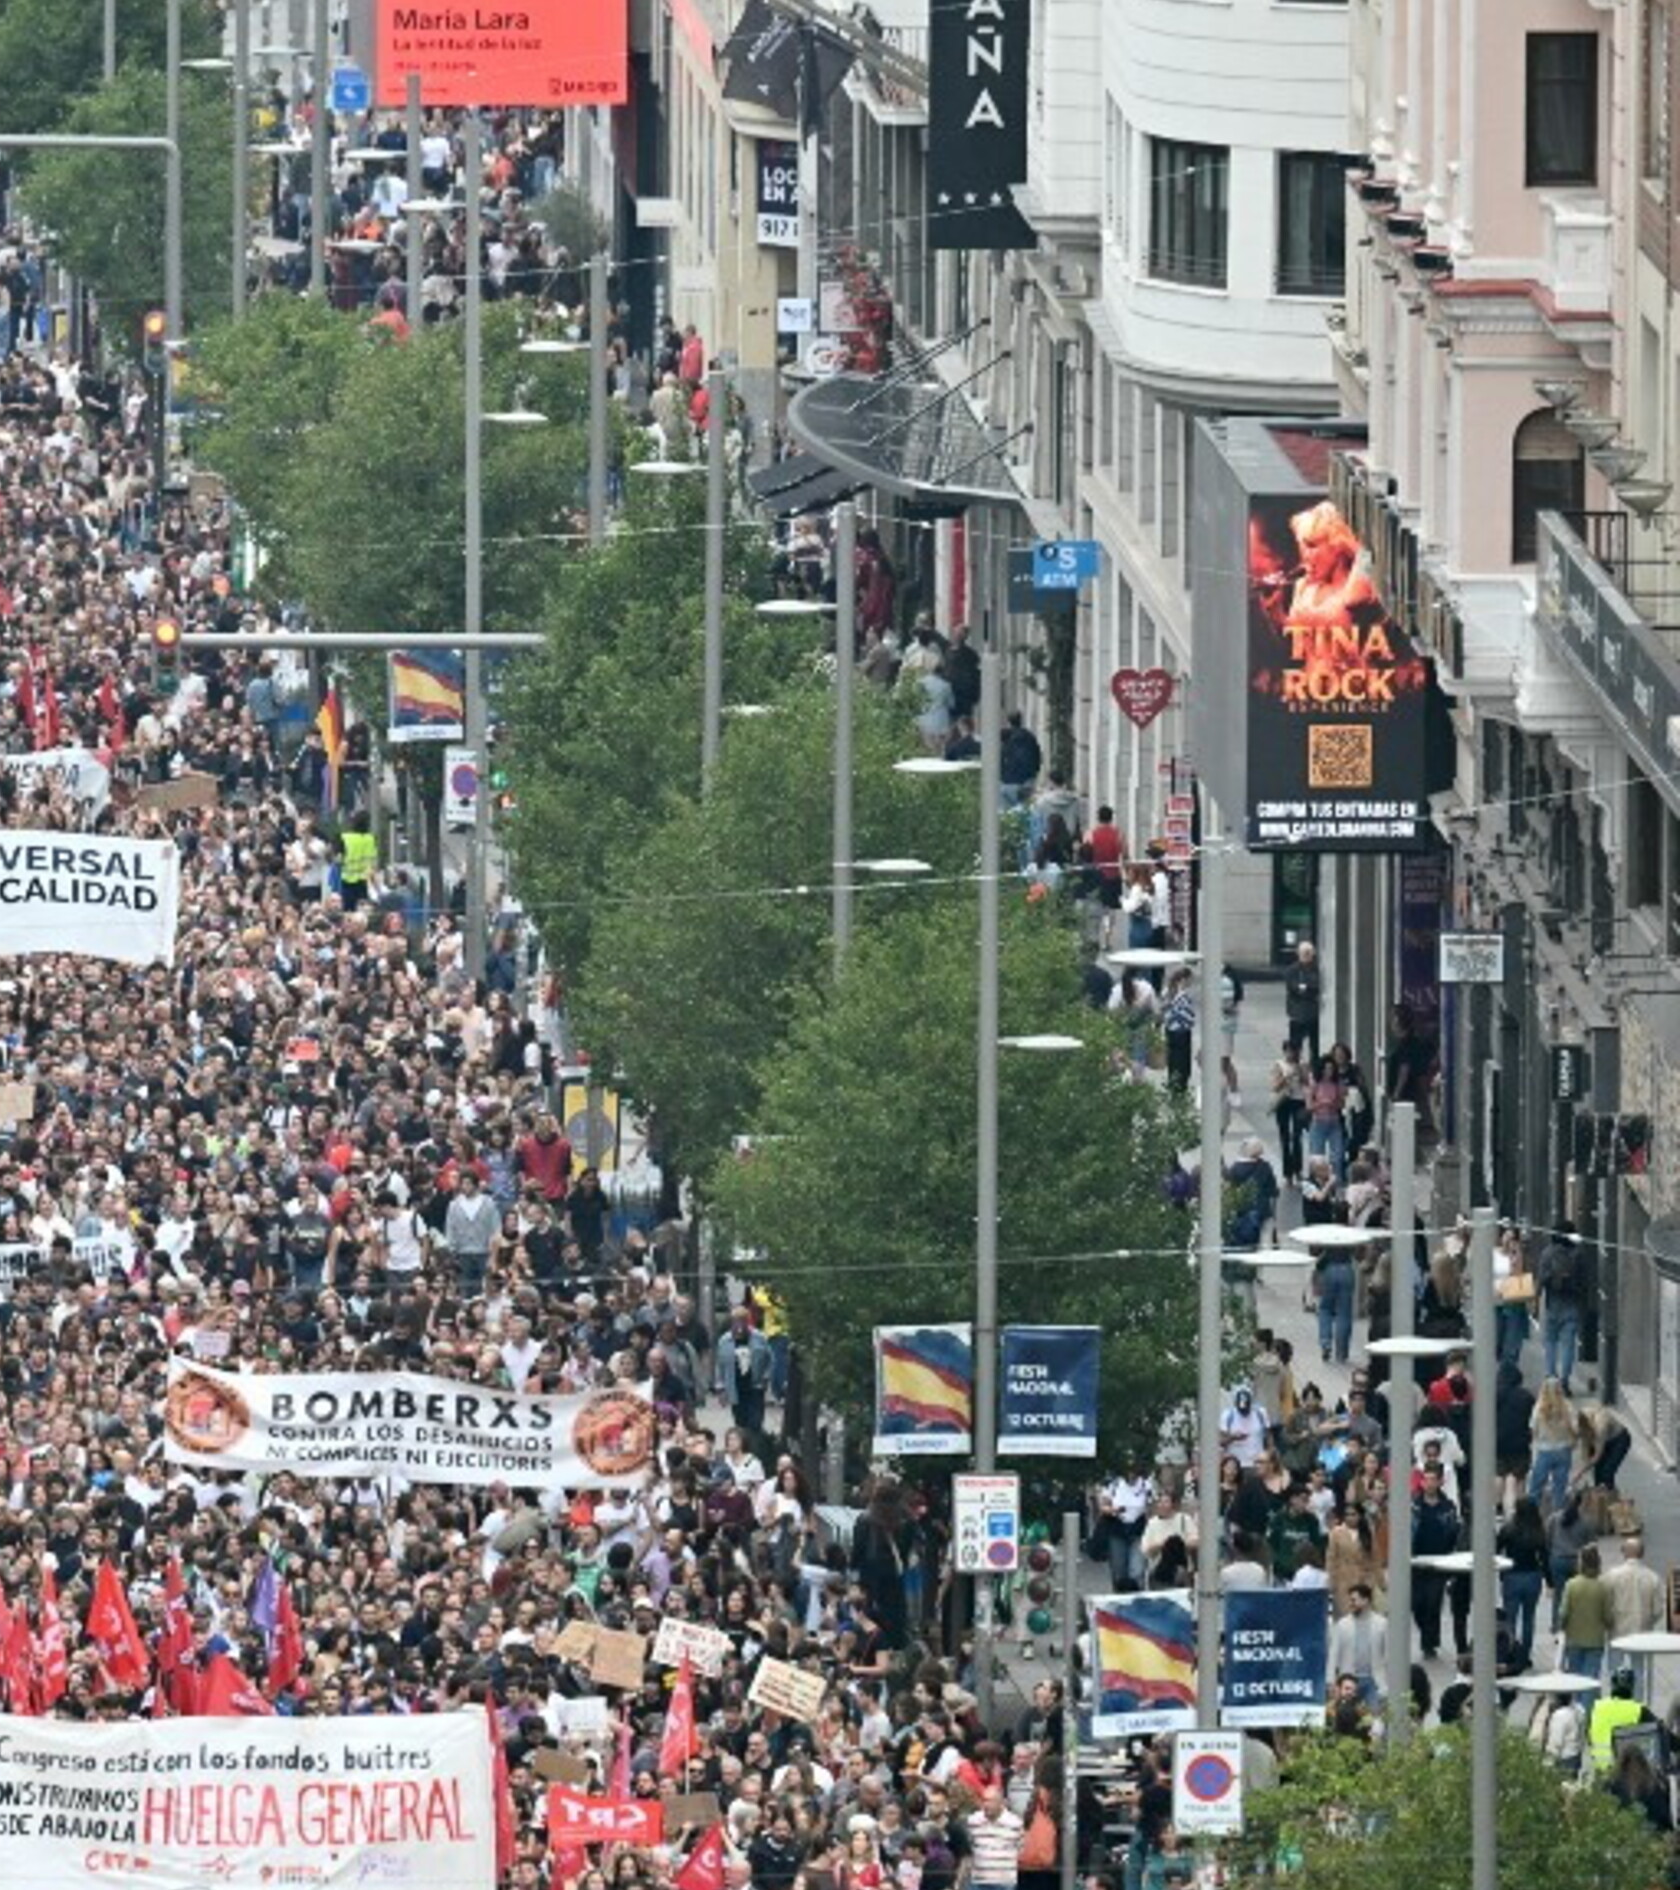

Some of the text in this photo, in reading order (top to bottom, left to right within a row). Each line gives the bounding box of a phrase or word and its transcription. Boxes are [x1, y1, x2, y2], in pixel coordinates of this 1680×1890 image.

[393, 8, 530, 30] María Lara
[1042, 573, 1077, 586] ATM
[1282, 626, 1395, 661] TINA
[1281, 669, 1396, 701] ROCK
[0, 878, 158, 912] CALIDAD
[1008, 1364, 1048, 1379] FIESTA
[1007, 1381, 1075, 1396] NACIONAL
[270, 1388, 553, 1430] BOMBERXS
[1023, 1413, 1086, 1430] OCTUBRE
[268, 1424, 553, 1452] CONTRA LOS DESAHUCIOS
[268, 1444, 290, 1459] NI
[406, 1449, 428, 1464] NI
[435, 1452, 553, 1471] EJECUTORES
[1233, 1630, 1275, 1645] FIESTA
[1233, 1647, 1303, 1662] NACIONAL
[1248, 1680, 1314, 1698] OCTUBRE
[104, 1749, 149, 1773] está
[154, 1752, 192, 1772] con
[199, 1745, 238, 1771] los
[240, 1745, 331, 1773] fondos
[342, 1744, 433, 1772] buitres
[142, 1778, 477, 1848] HUELGA GENERAL
[39, 1813, 108, 1840] ABAJO
[110, 1820, 137, 1843] LA
